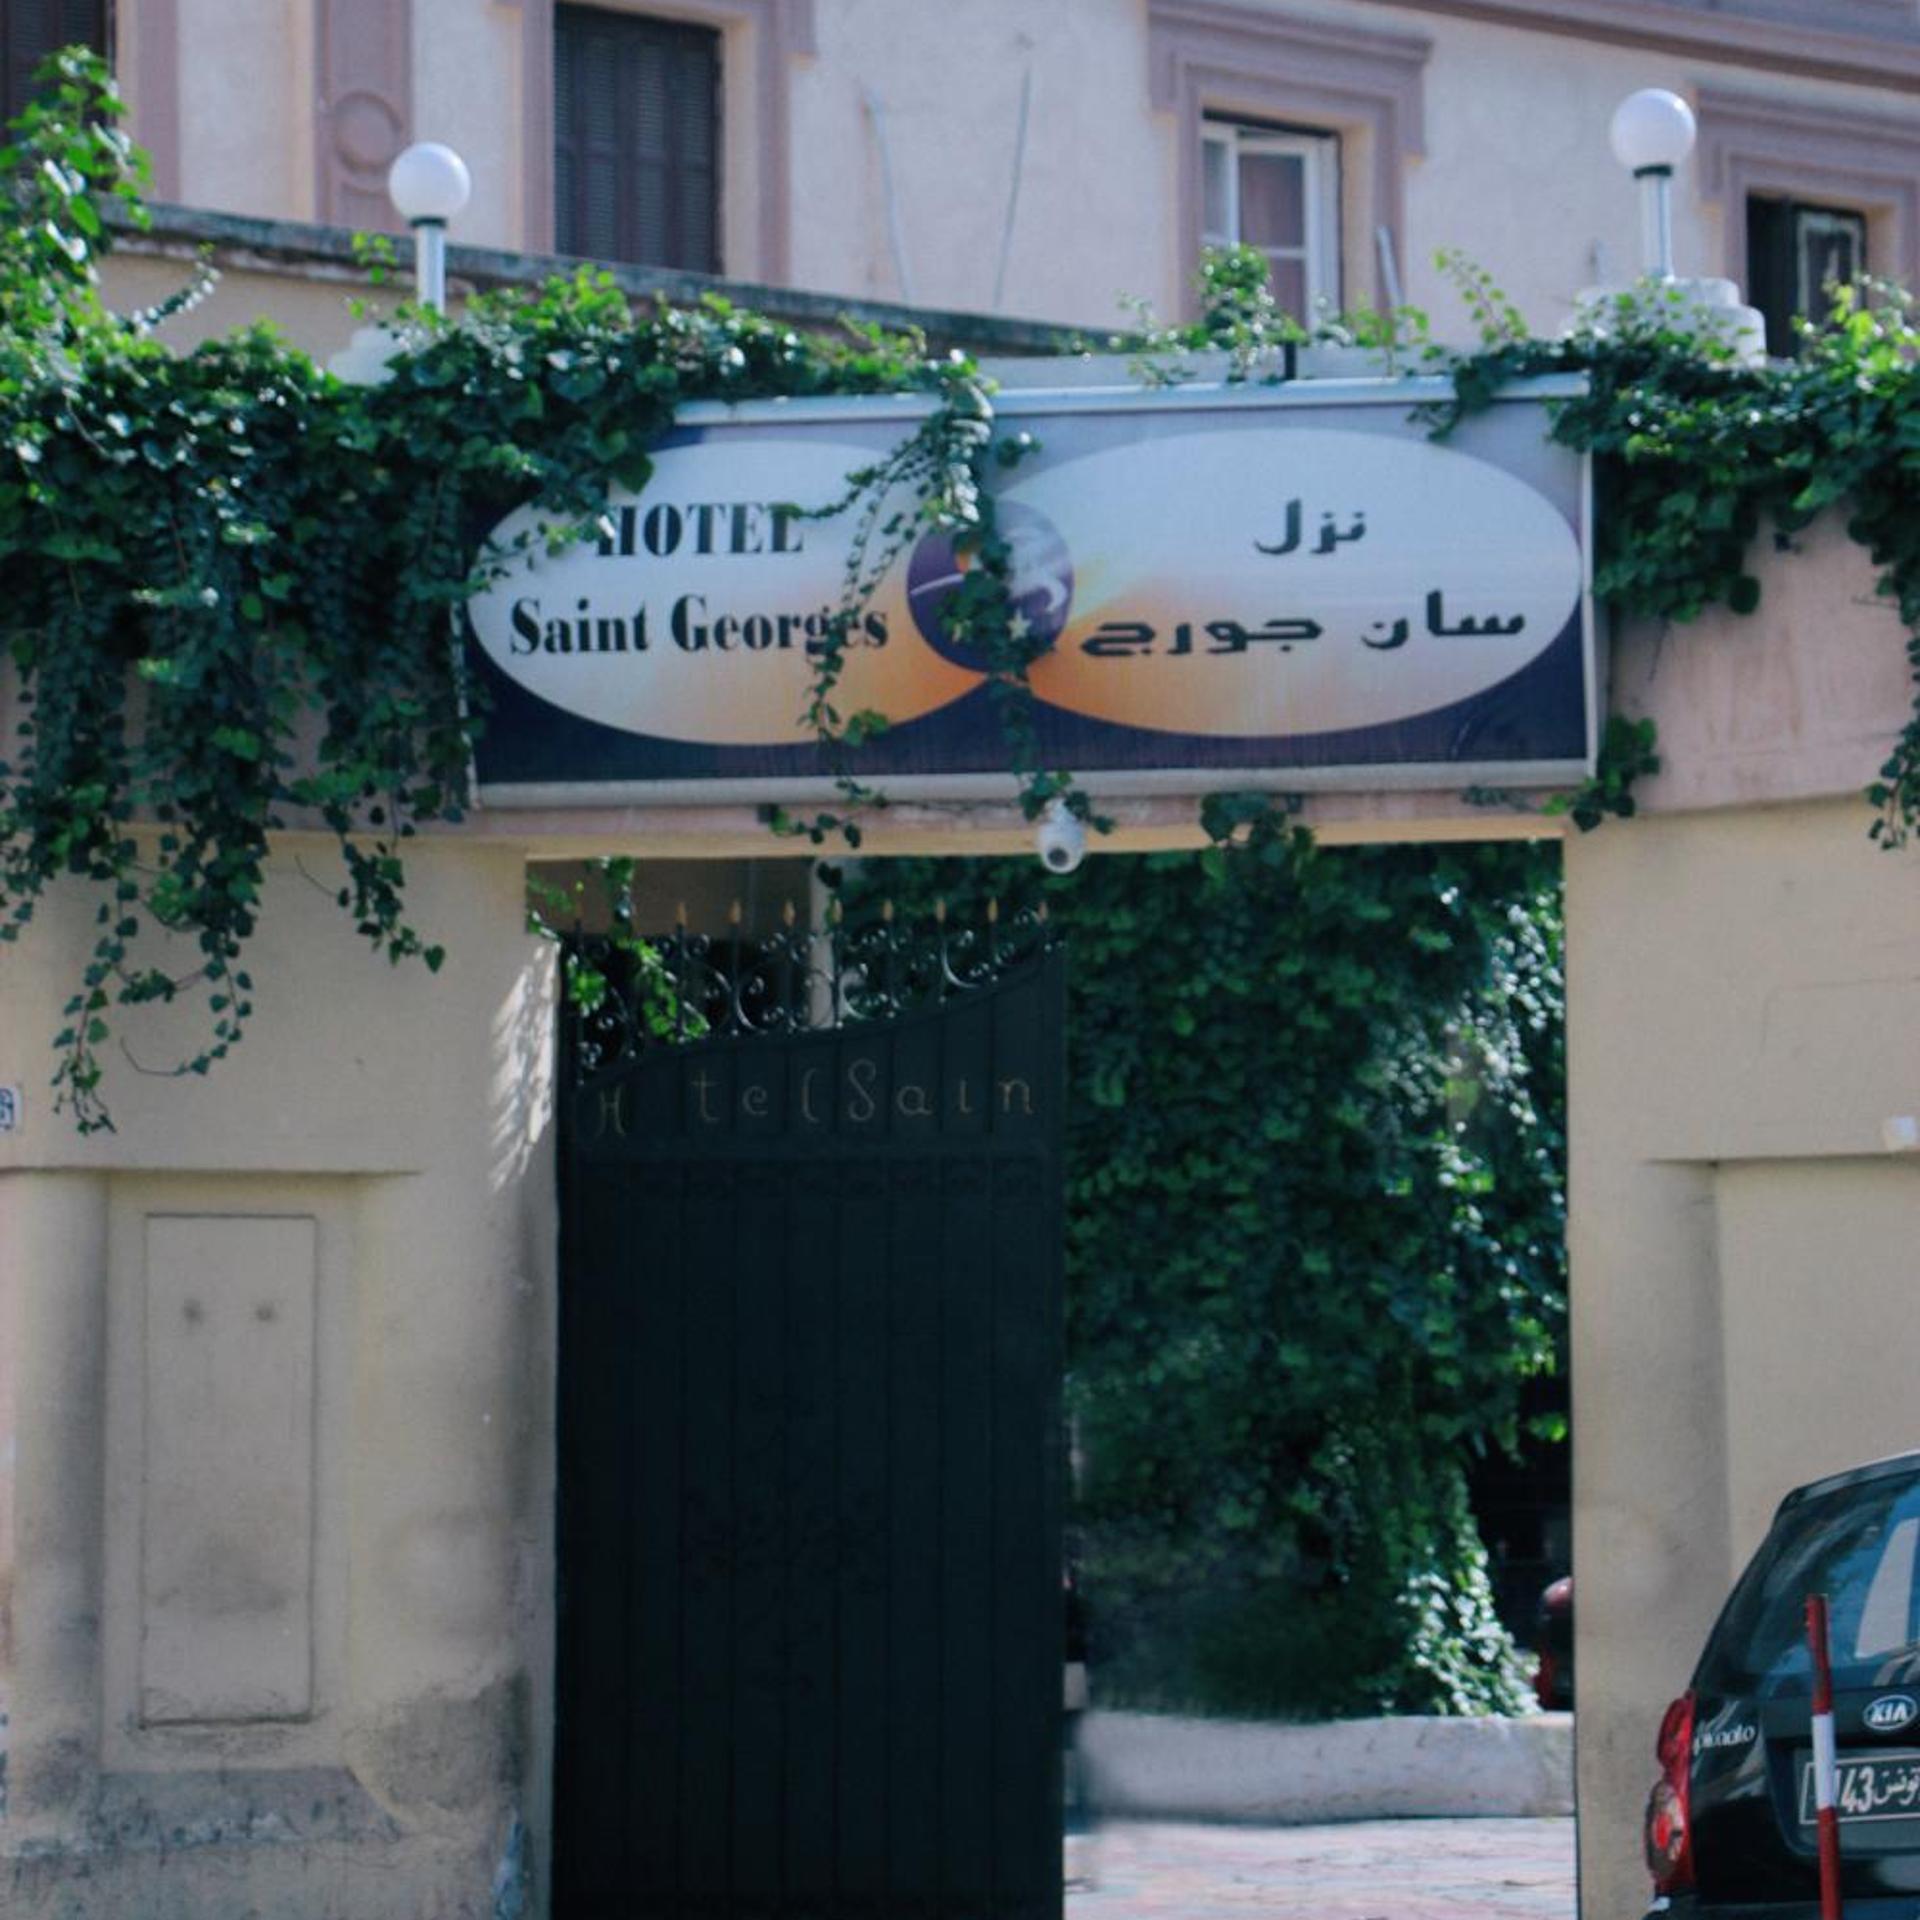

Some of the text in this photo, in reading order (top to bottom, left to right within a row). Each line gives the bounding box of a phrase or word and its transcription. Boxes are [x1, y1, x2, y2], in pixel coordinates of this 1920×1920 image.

[1254, 498, 1366, 555] نزل
[511, 598, 649, 655] Saint
[1080, 590, 1525, 657] سان جورج
[1871, 1701, 1908, 1722] KIA
